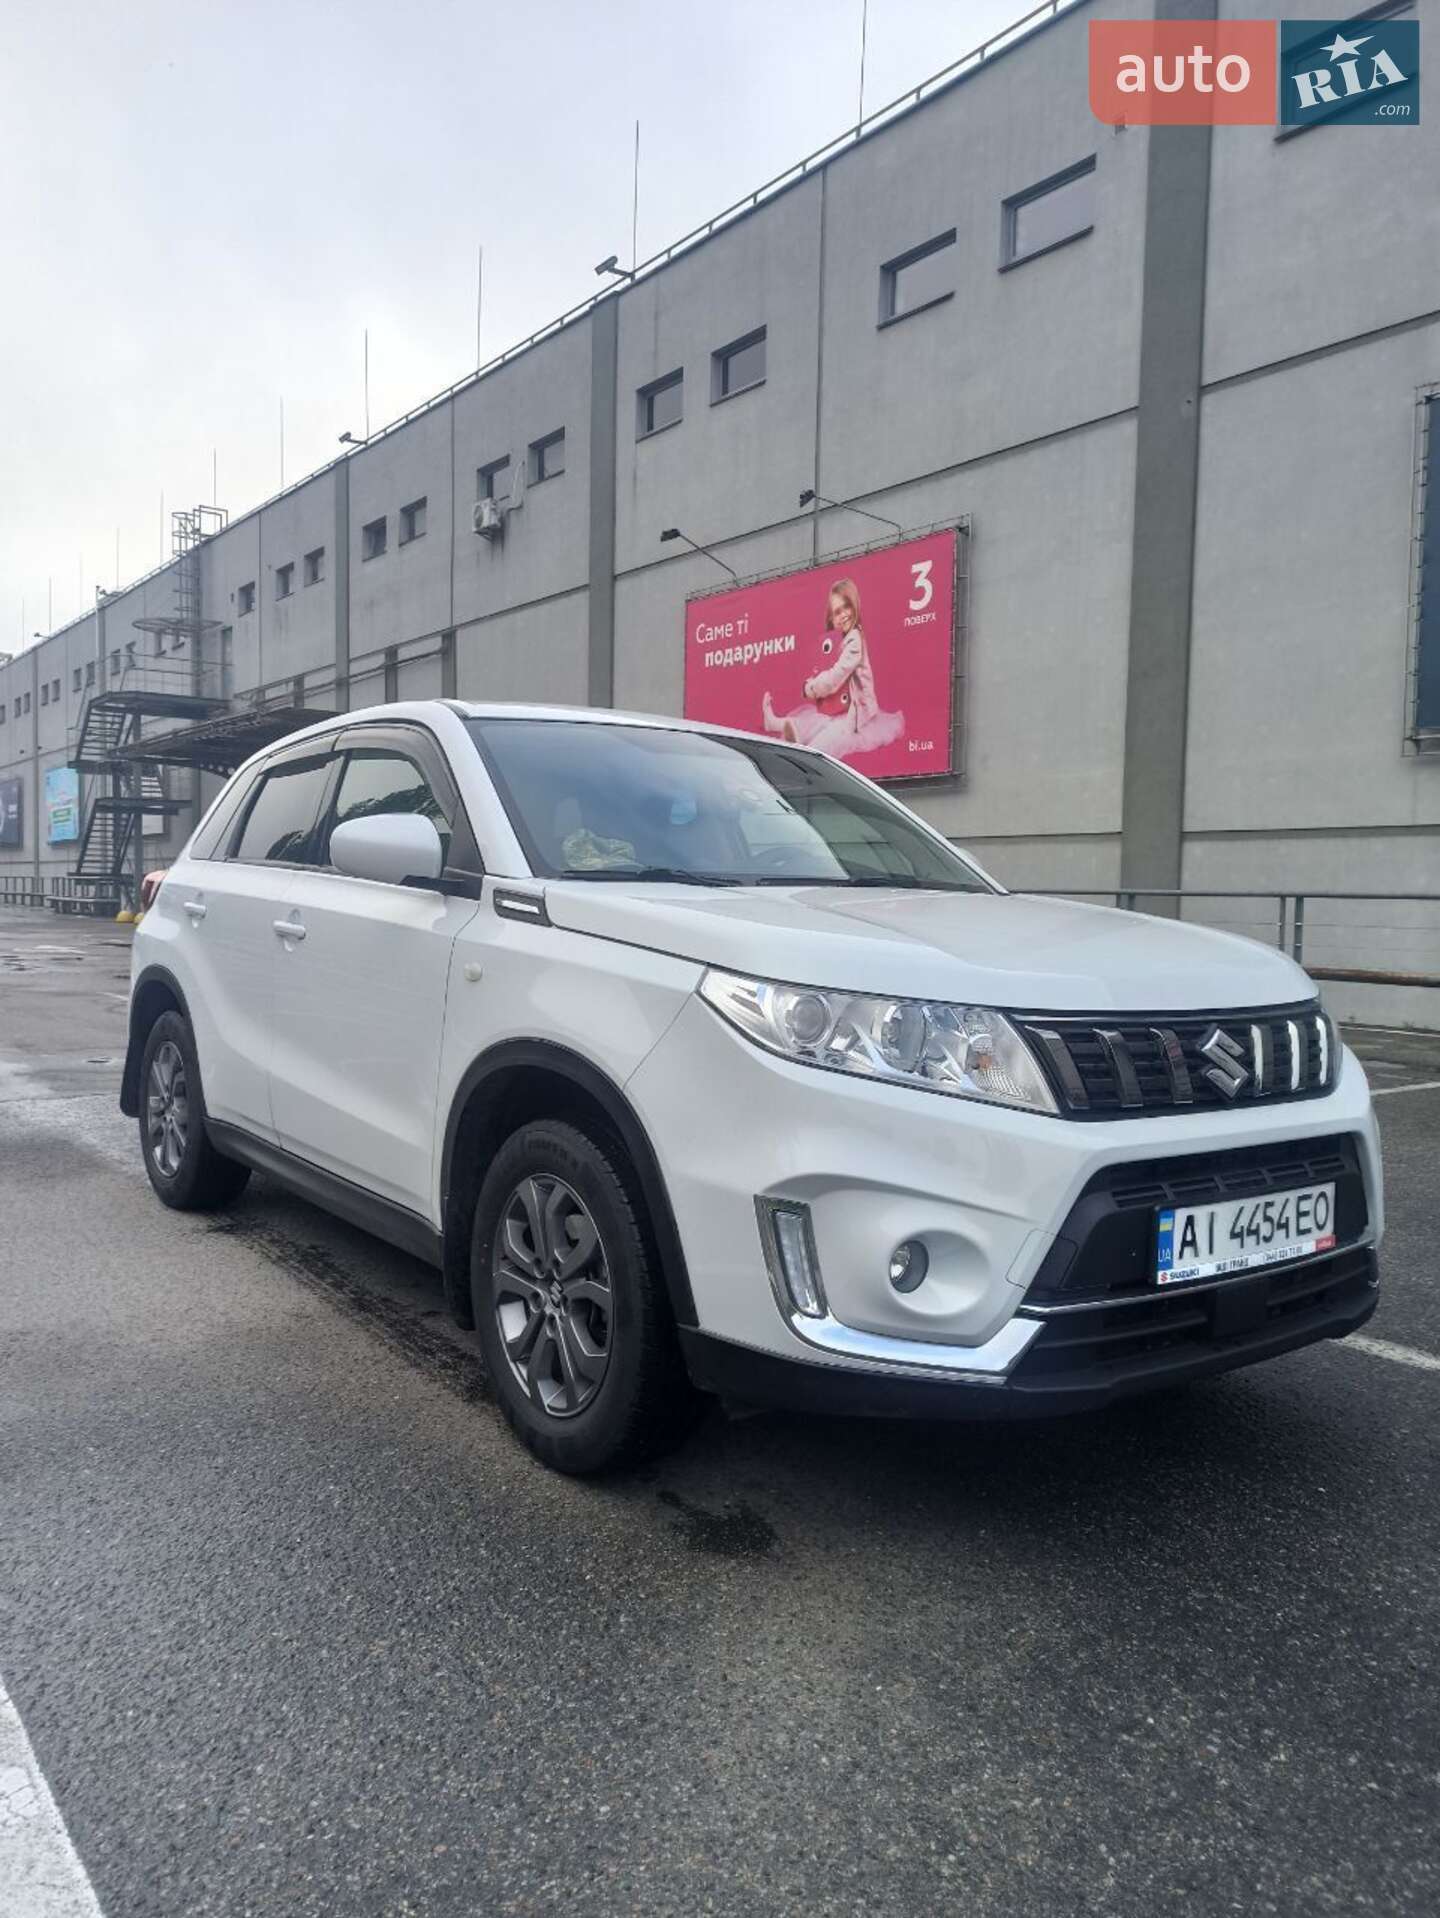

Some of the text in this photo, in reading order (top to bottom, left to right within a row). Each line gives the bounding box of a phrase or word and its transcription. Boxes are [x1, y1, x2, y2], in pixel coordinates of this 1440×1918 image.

[909, 560, 933, 611] 3
[696, 612, 749, 644] Саме ті
[904, 612, 936, 627] ПОВЕРХ
[705, 635, 795, 667] подарунки
[908, 739, 934, 752] bi.ua
[1178, 1211, 1216, 1260] AI
[1158, 1247, 1172, 1263] UA
[1169, 1268, 1200, 1280] SUZUKI
